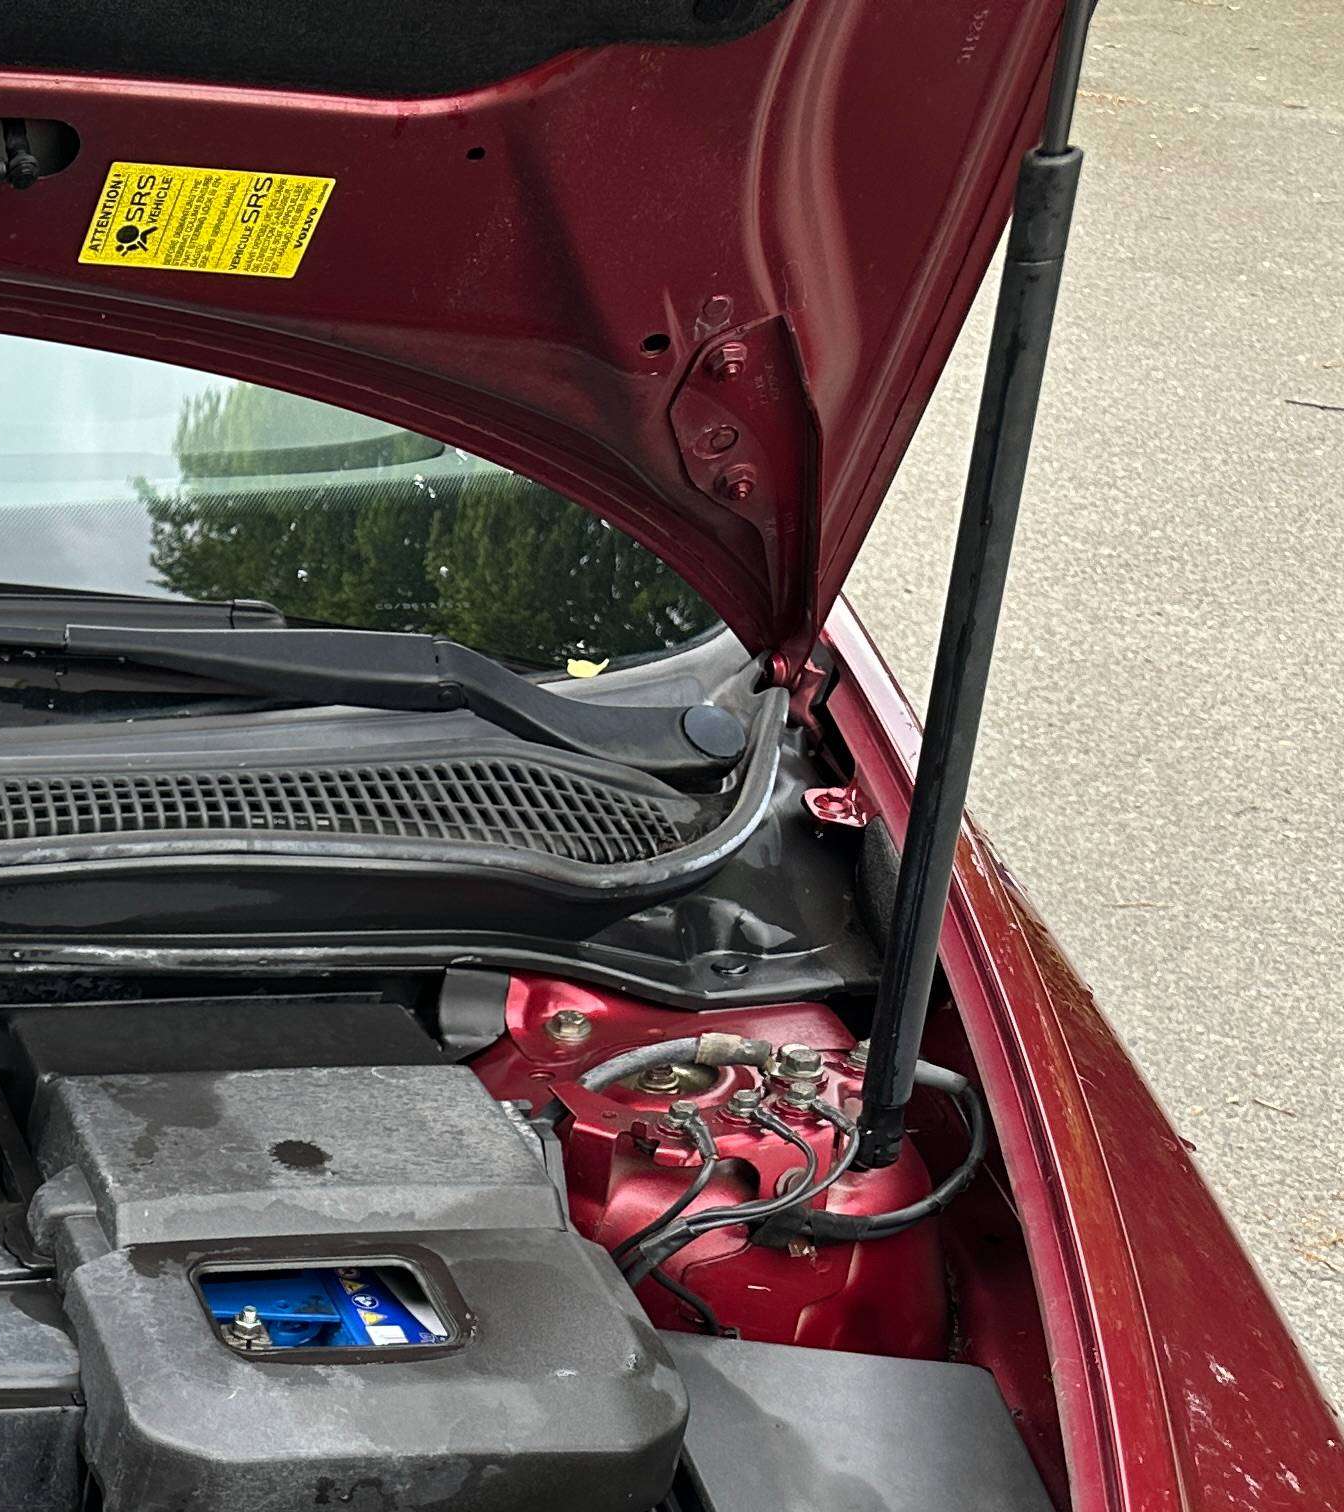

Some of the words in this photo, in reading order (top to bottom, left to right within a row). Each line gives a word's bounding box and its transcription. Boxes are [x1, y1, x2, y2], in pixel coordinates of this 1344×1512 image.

[87, 179, 124, 251] ATTENTION
[123, 174, 158, 222] SRS
[146, 176, 174, 223] VEHICLE
[238, 176, 275, 224] SRS
[227, 225, 255, 270] VEHICULE
[292, 207, 319, 249] VOLVO
